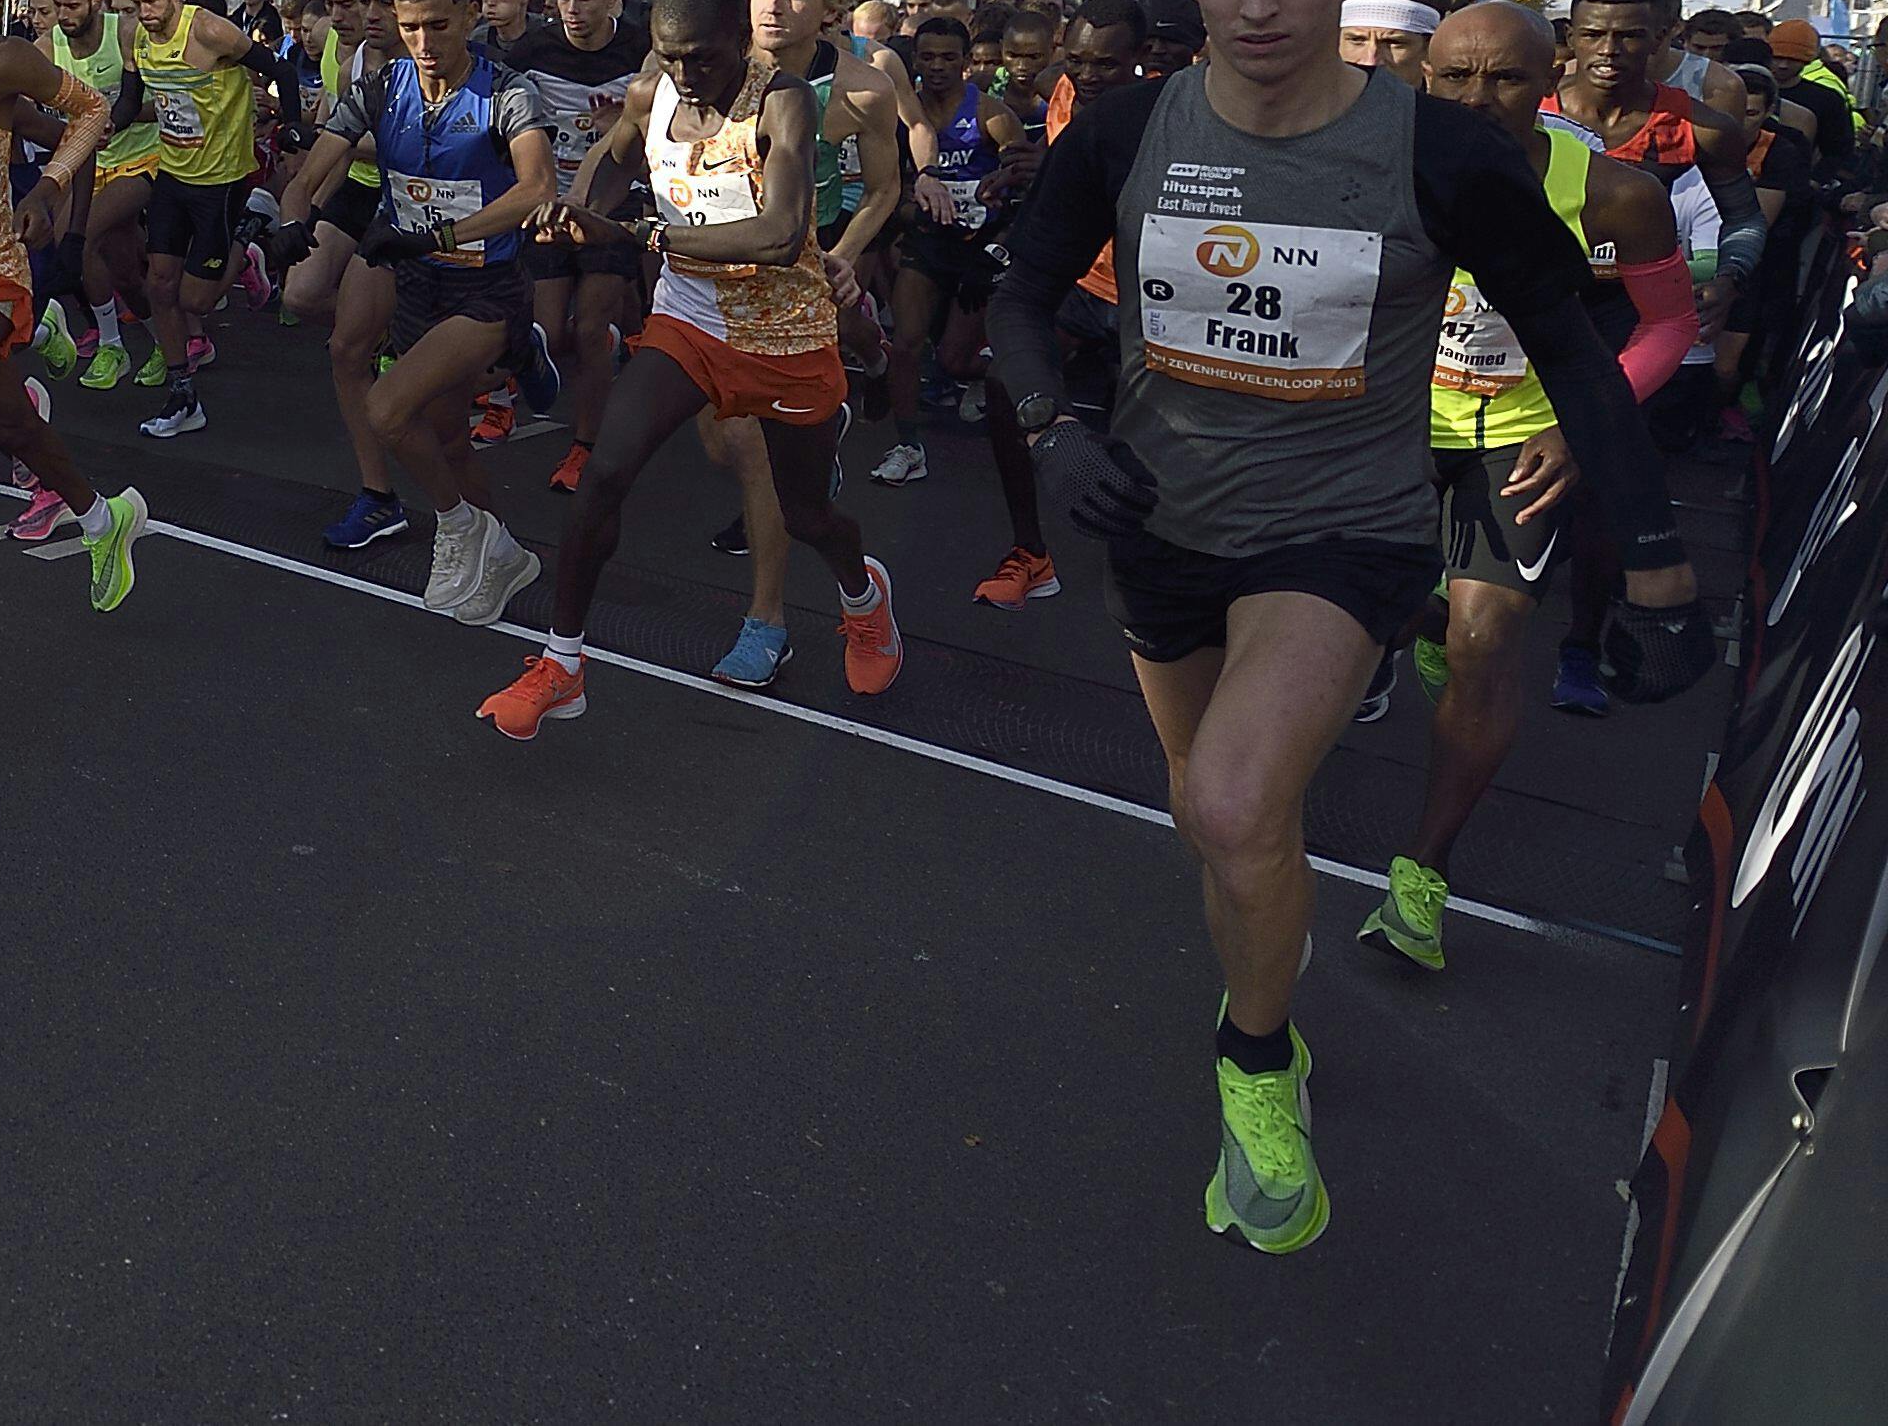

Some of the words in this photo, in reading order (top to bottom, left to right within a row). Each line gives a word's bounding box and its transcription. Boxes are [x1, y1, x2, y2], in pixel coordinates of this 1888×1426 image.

[662, 159, 677, 168] NN
[435, 188, 456, 199] NN
[697, 188, 720, 199] NN
[1157, 196, 1180, 211] East
[1182, 199, 1208, 213] River
[1209, 202, 1242, 217] Invest
[1273, 246, 1319, 267] NN
[1226, 282, 1282, 321] 28
[1206, 318, 1300, 359] Frank
[1168, 356, 1324, 390] ZEVENHEUVELENLOOP
